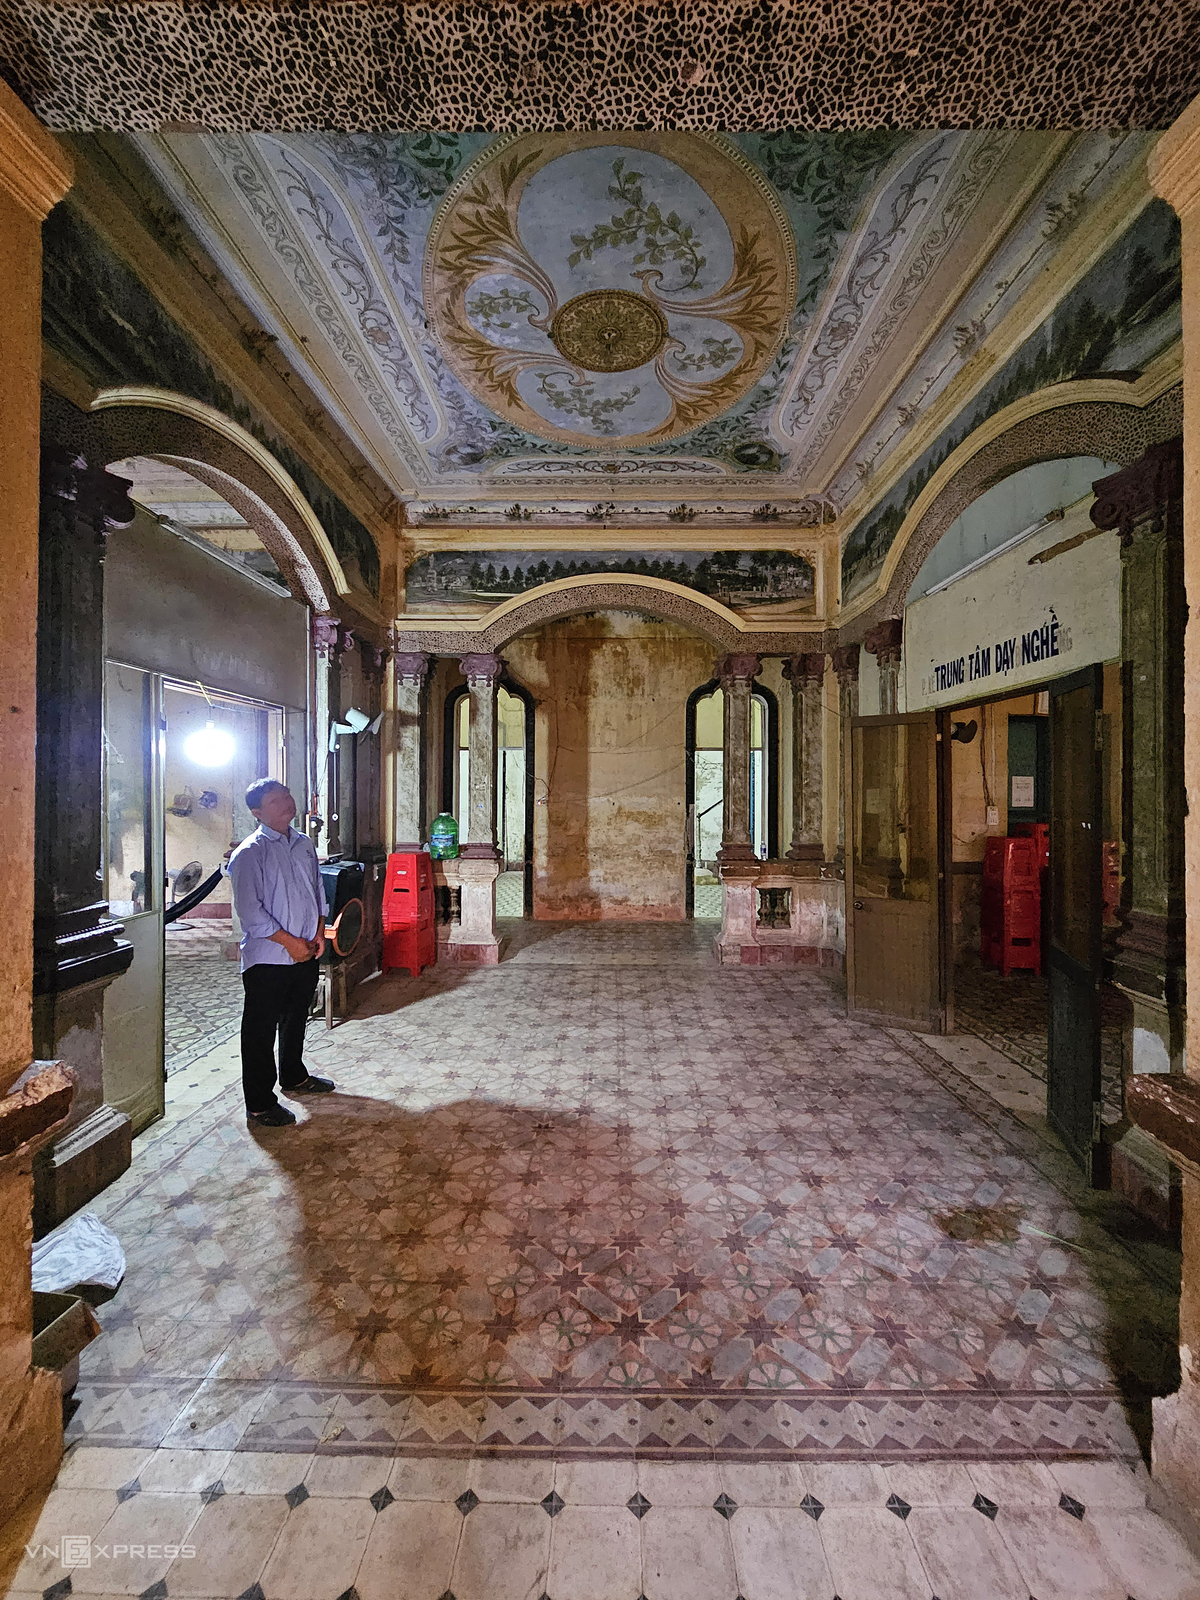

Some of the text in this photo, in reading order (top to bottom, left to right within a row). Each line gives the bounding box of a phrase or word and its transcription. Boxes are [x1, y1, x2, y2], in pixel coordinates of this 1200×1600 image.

[934, 656, 965, 692] TRUNG
[968, 645, 991, 681] TÂM
[995, 637, 1017, 677] DẠY
[1021, 607, 1060, 666] NGHỀ
